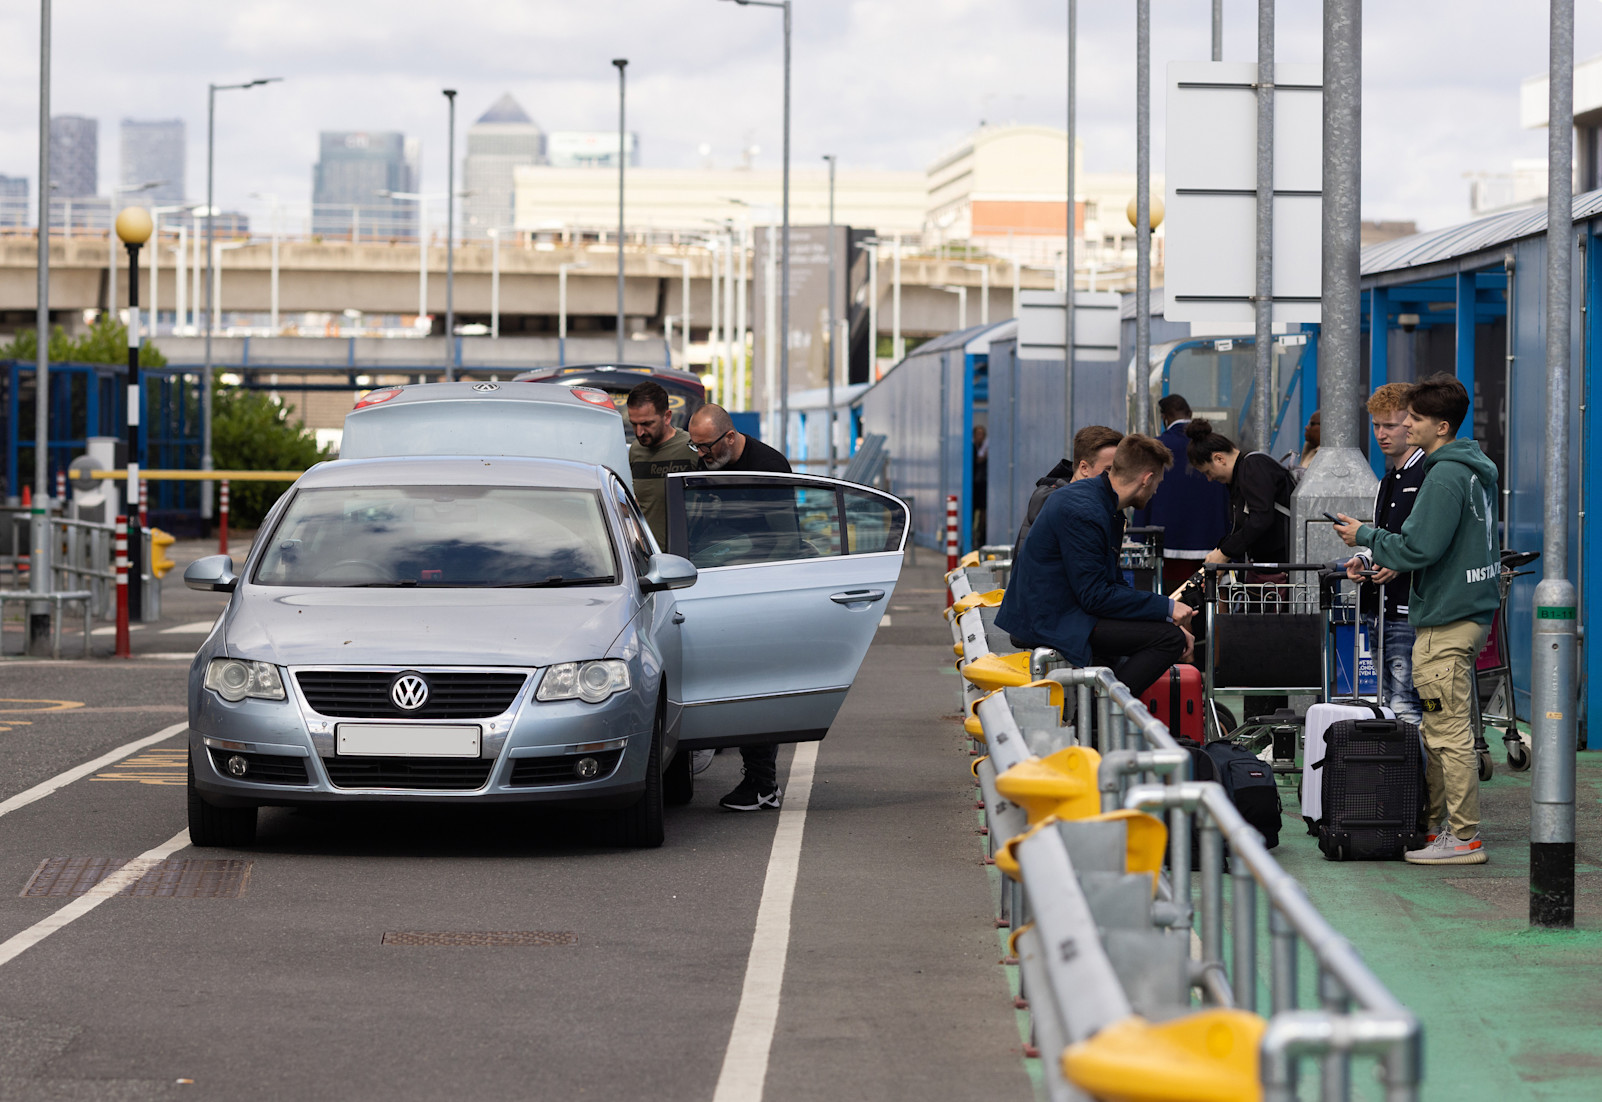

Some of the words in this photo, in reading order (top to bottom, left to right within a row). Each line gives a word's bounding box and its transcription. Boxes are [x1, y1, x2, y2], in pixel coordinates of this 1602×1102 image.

[650, 461, 688, 477] Replay
[1541, 610, 1573, 618] B1-11
[1359, 633, 1372, 658] L
[392, 675, 429, 710] VW
